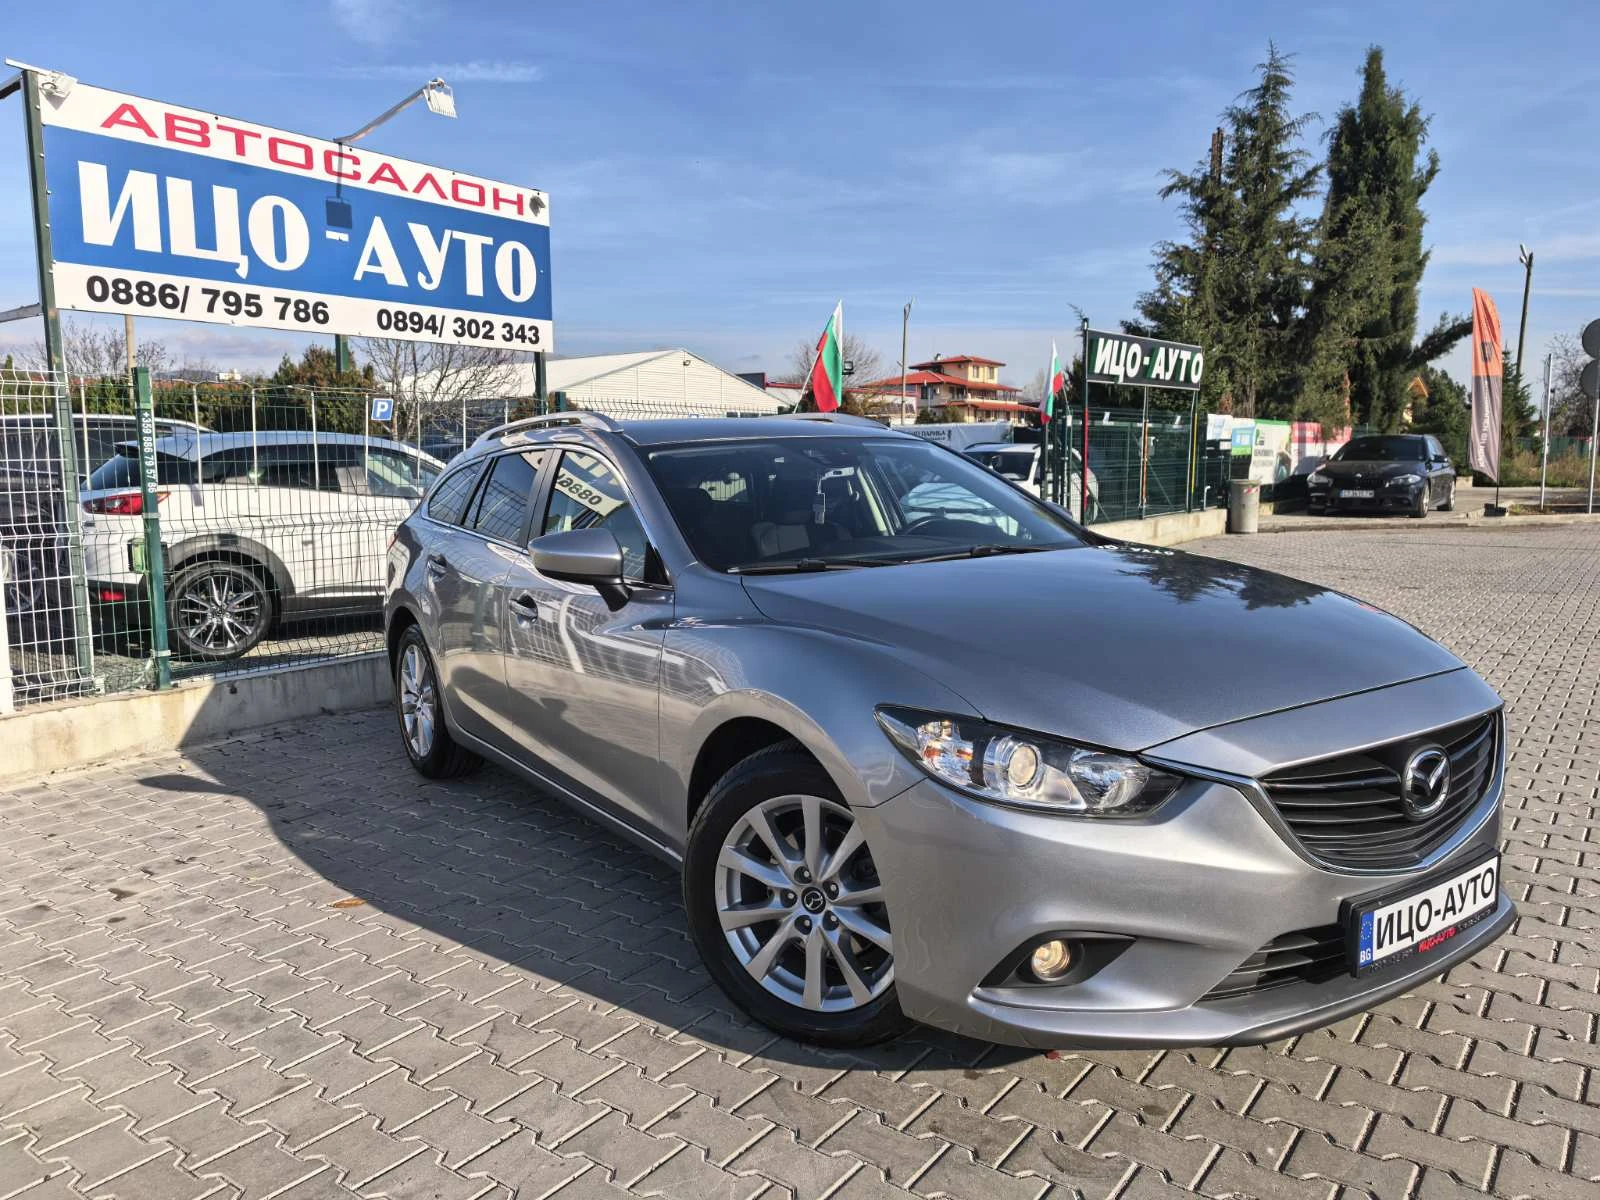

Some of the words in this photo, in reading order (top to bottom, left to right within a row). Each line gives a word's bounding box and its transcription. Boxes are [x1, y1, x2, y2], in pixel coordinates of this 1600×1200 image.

[100, 102, 525, 217] АВТОСАЛОН
[86, 275, 190, 313] 0886/
[201, 288, 263, 319] 795
[274, 296, 330, 325] 786
[377, 307, 446, 338] 0894/
[453, 317, 495, 341] 302
[501, 321, 540, 344] 343
[1094, 337, 1203, 384] ИЦО-АУТО
[376, 402, 389, 418] P
[143, 436, 153, 453] 886
[144, 455, 154, 467] 79
[1376, 866, 1495, 950] ИЦО-АУТО
[1360, 949, 1371, 963] BG
